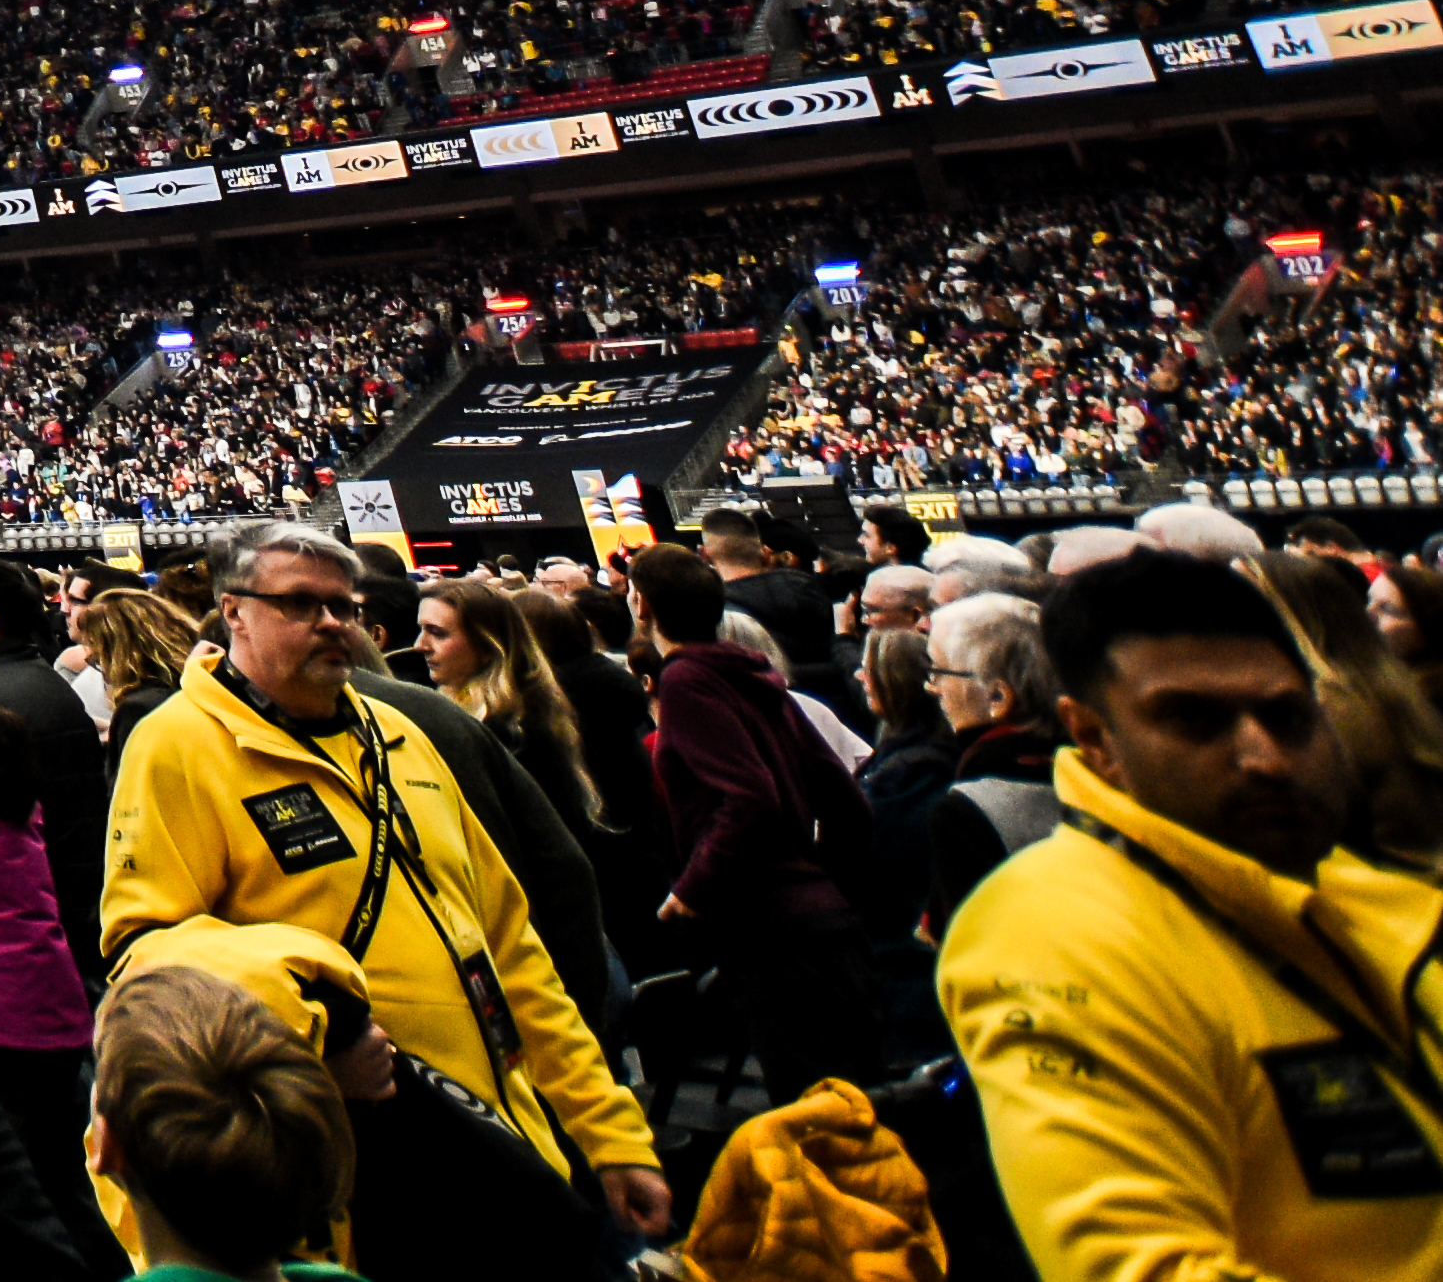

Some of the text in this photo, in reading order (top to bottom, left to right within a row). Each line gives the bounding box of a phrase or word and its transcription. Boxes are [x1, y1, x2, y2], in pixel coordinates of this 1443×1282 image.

[1278, 24, 1291, 39] I
[421, 37, 445, 51] 454
[1152, 34, 1241, 56] INVICTUS
[1272, 39, 1314, 58] AM
[1164, 47, 1232, 66] GAMES
[900, 74, 914, 91] I
[119, 85, 140, 98] 453
[893, 88, 933, 109] AM
[615, 109, 684, 127] INVICTUS
[577, 122, 586, 135] I
[624, 120, 676, 137] GAMES
[406, 138, 467, 155] INVICTUS
[571, 134, 601, 150] AM
[301, 157, 309, 170] I
[413, 150, 460, 163] GAMES
[222, 164, 277, 179] INVICTUS
[296, 170, 323, 184] AM
[227, 173, 270, 187] GAMES
[54, 188, 63, 201] I
[48, 200, 75, 216] AM
[1284, 256, 1323, 276] 202
[829, 289, 860, 305] 201
[500, 317, 526, 333] 254
[480, 365, 734, 395] INVICTUS
[488, 383, 681, 407] GAMES
[585, 398, 673, 410] WHISTLER
[439, 480, 533, 499] INVICTUS
[450, 497, 522, 514] GAMES
[907, 501, 957, 520] EXIT
[107, 534, 137, 546] EXIT
[255, 791, 311, 815] INVICTUS
[266, 803, 310, 823] GAMES
